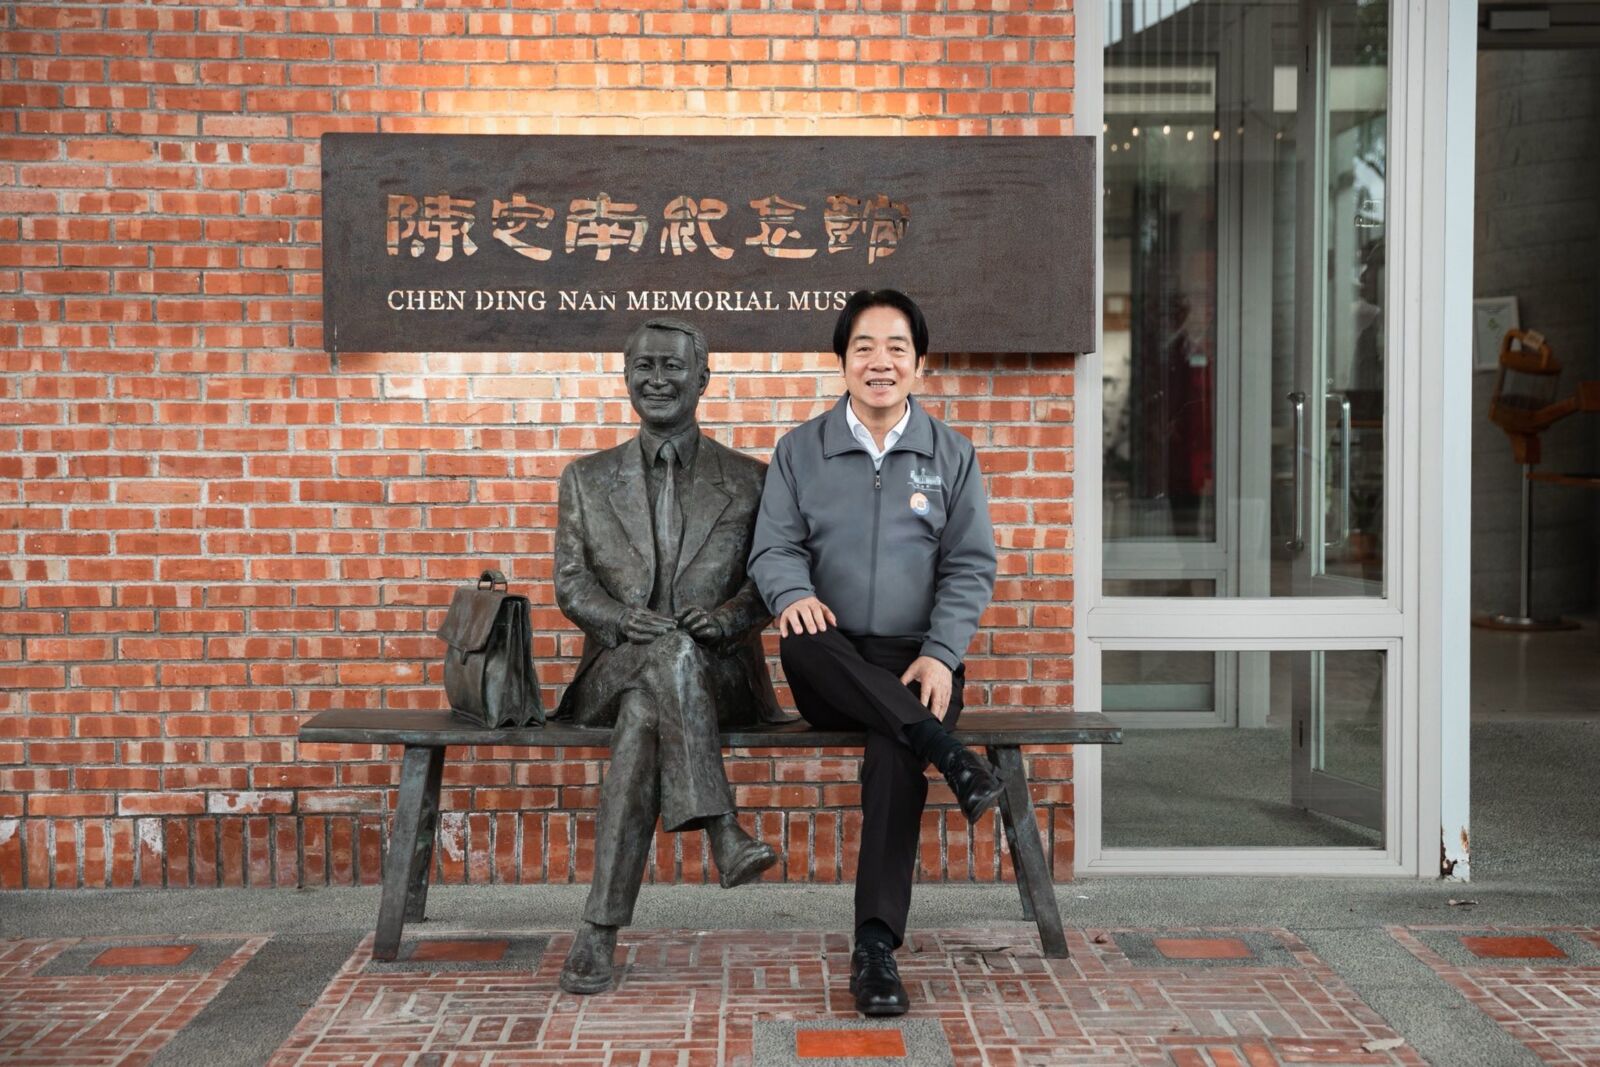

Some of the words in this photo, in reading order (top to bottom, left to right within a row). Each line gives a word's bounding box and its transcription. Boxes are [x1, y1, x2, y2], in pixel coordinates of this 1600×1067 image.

[386, 192, 911, 264] 陳定南紀念館
[387, 290, 466, 311] CHEN
[475, 290, 547, 311] DING
[558, 290, 616, 311] NAN
[626, 290, 780, 311] MEMORIAL
[787, 290, 875, 311] MUS
